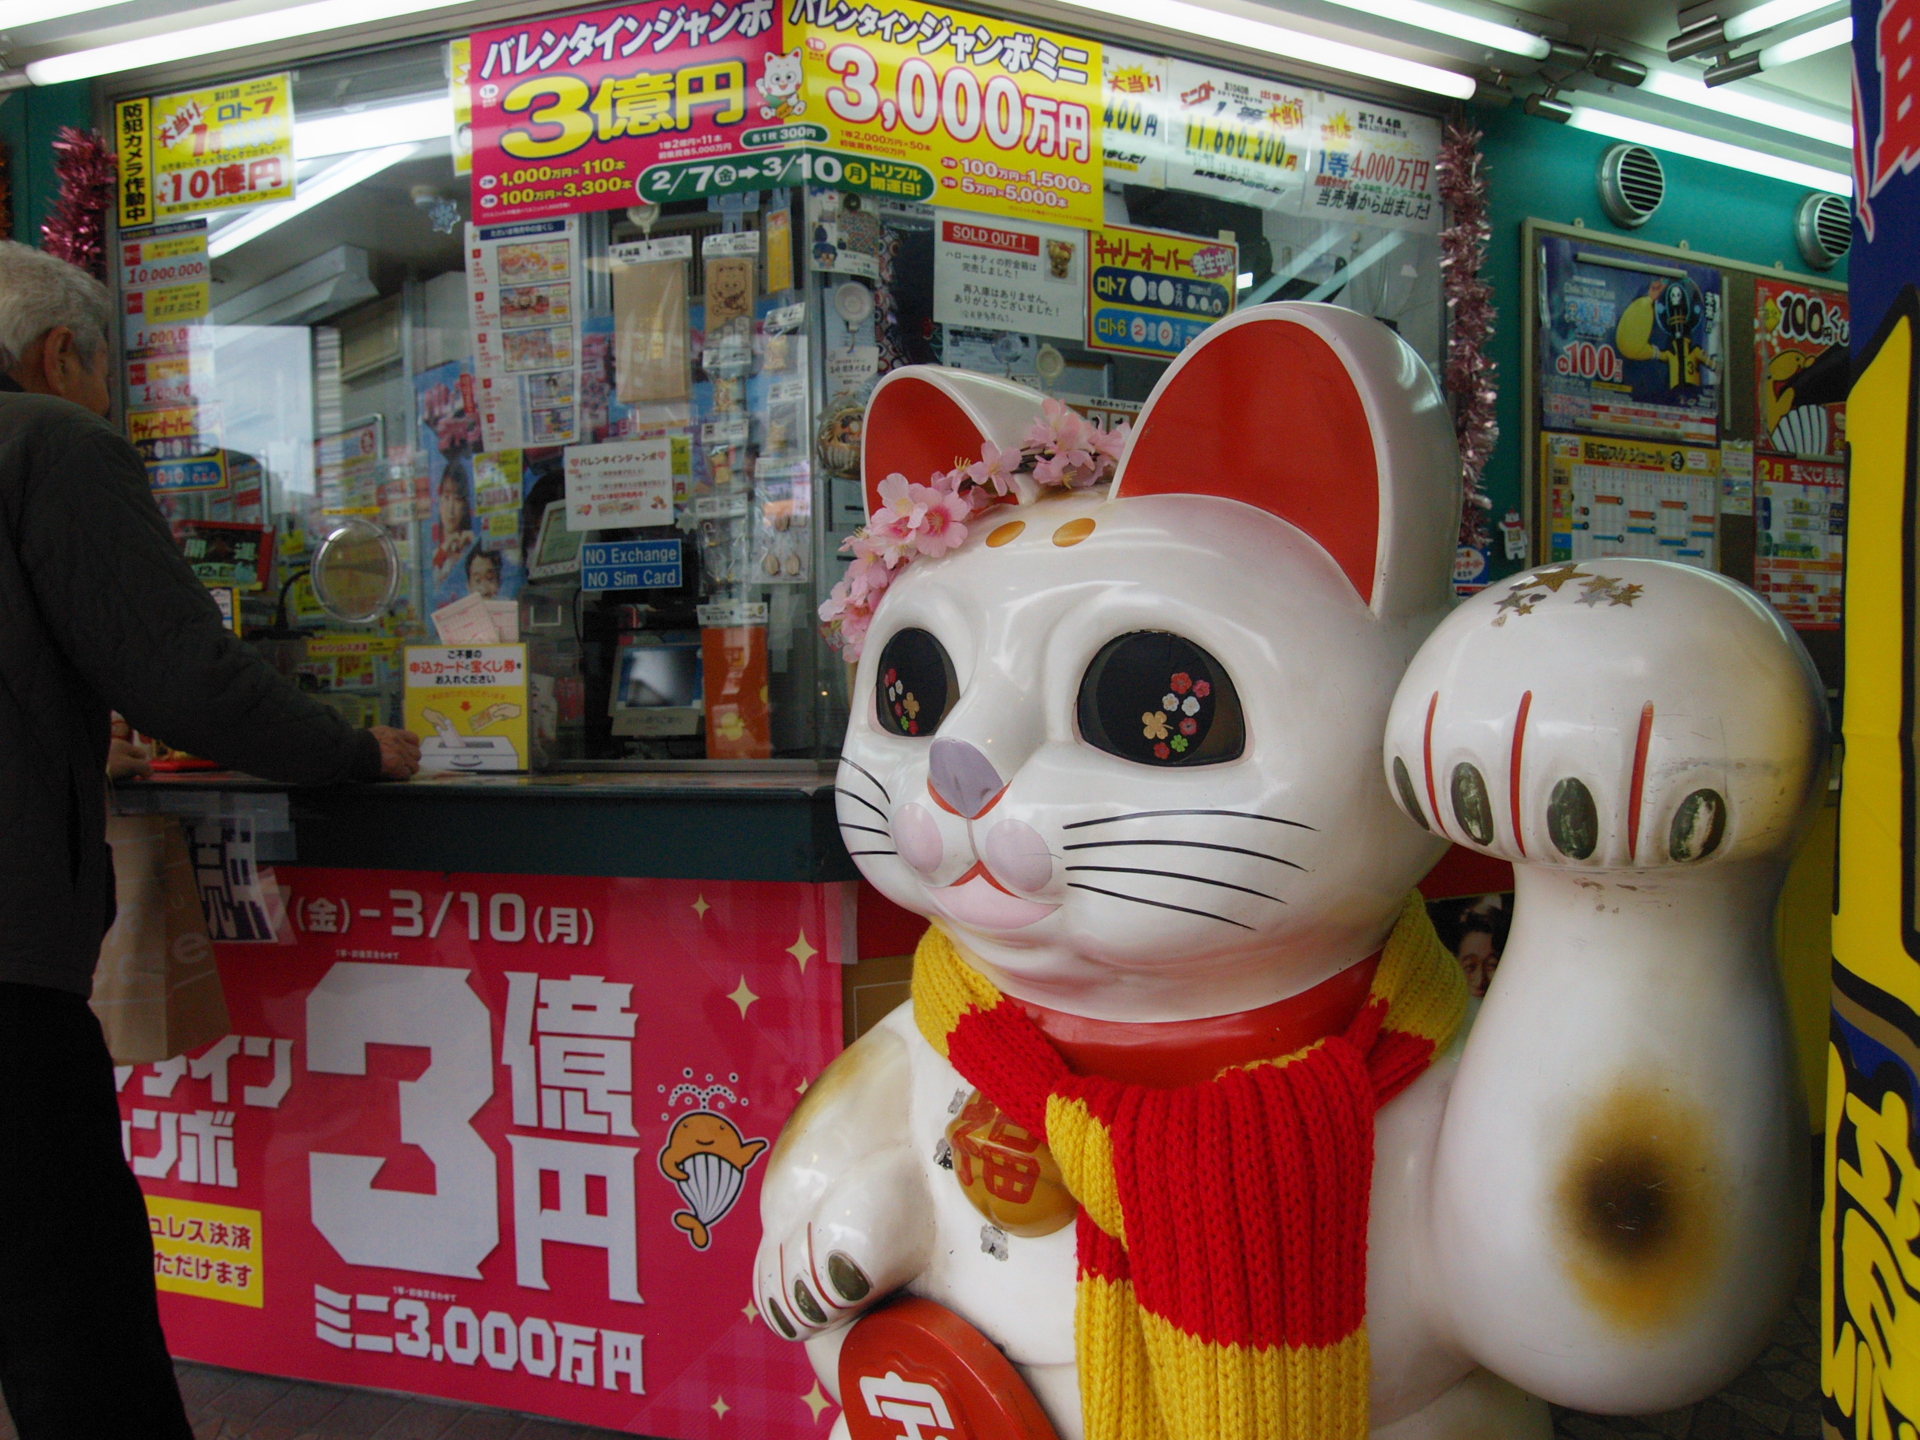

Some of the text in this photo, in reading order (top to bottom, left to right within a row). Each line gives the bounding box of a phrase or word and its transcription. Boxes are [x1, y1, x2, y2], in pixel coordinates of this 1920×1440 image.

[789, 0, 1089, 84] バレンタインジャンボミニ
[1108, 74, 1161, 94] 大当り
[500, 60, 744, 159] 3億円
[826, 44, 1090, 163] 3,000万円
[1358, 111, 1401, 129] 第744回
[780, 126, 816, 141] 300円
[121, 103, 147, 221] 防犯カメラ作動中
[500, 157, 626, 188] 1,000万円×110本
[870, 162, 922, 181] トリプル
[1318, 148, 1350, 178] 1等
[1349, 149, 1431, 192] 4,000万円
[171, 156, 283, 203] 10億円
[869, 178, 921, 197] 開運日!
[960, 158, 1091, 195] 100万円×1,500本
[500, 176, 633, 207] 100万円×3,300本
[961, 176, 1068, 209] 5万円×5,000本
[1316, 188, 1430, 220] 当売場から出ました!
[953, 225, 990, 244] SOLD
[991, 231, 1020, 249] OUT
[945, 250, 1038, 271] ハローキティの貯金箱は
[1095, 237, 1191, 272] キャリーオーバー
[961, 261, 1020, 279] 完売しました!
[962, 283, 1050, 305] 再入庫はありません。
[1097, 276, 1128, 297] ロト7
[953, 293, 1061, 318] ありがとうございました!
[1098, 318, 1127, 337] ロト6
[579, 454, 659, 468] バレンタインジャンボ
[1757, 458, 1785, 482] 2月
[584, 547, 677, 566] NO Exchange
[588, 569, 676, 587] NO Sim Card
[435, 675, 496, 686] お入れください
[304, 961, 645, 1304] 3億円
[121, 1107, 239, 1189] ンボ
[314, 1282, 645, 1396] ミニ3,000万円
